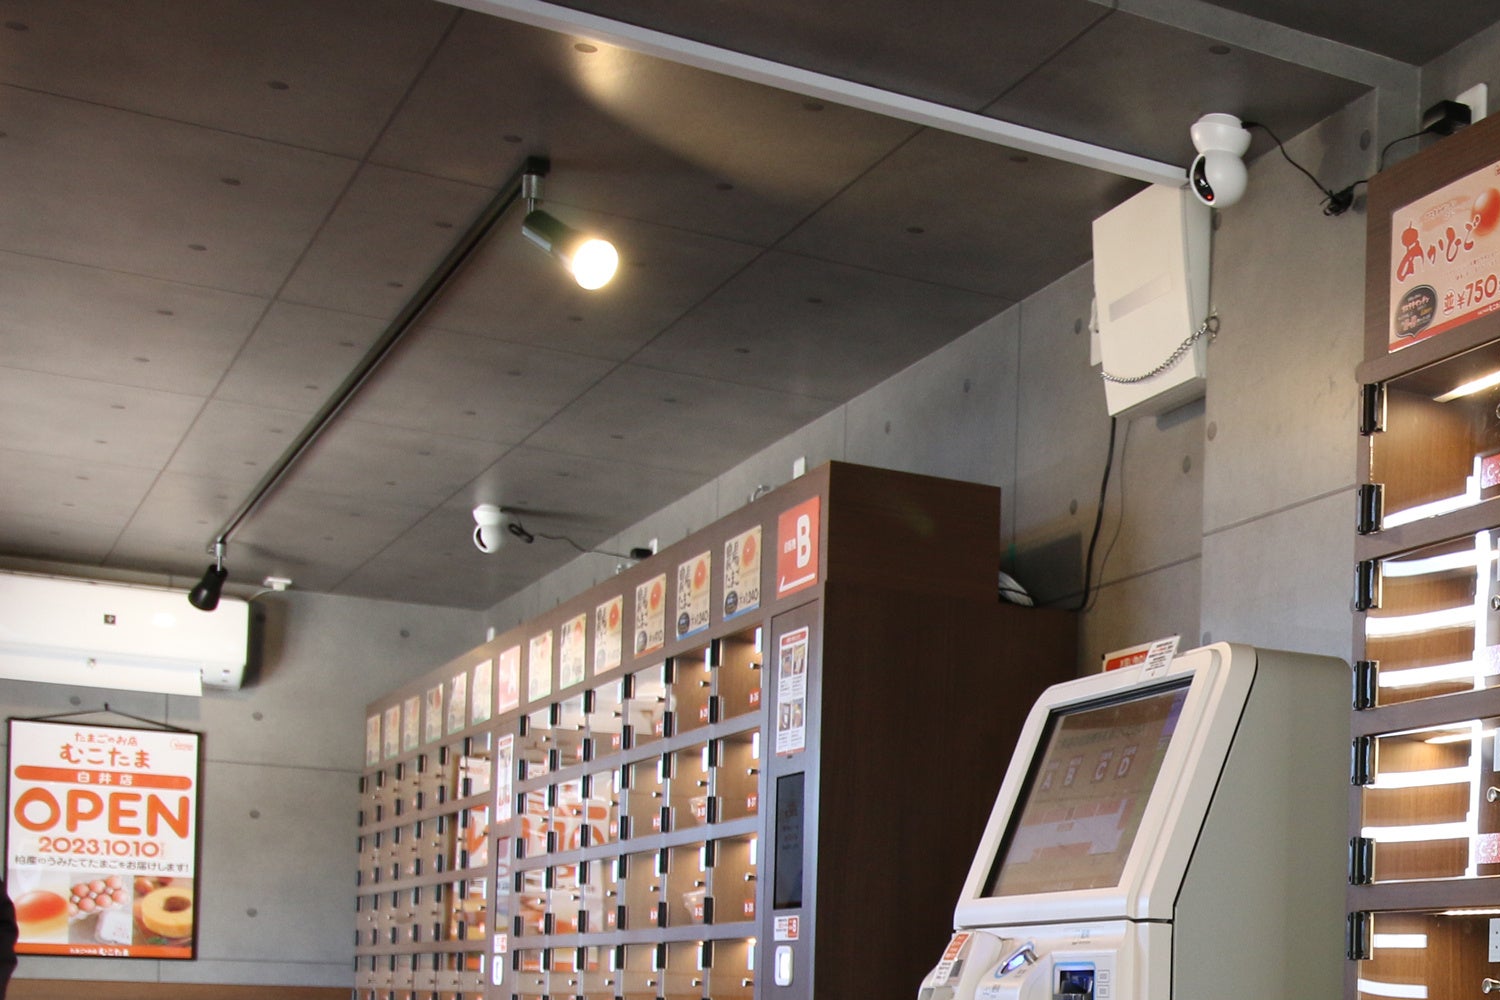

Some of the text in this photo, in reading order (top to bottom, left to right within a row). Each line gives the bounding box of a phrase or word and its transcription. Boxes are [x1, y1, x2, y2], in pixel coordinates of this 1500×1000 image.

[1397, 215, 1480, 282] あかひご
[797, 514, 811, 569] B
[59, 743, 151, 769] むこたま
[76, 773, 133, 786] 白井店
[14, 787, 190, 839] OPEN
[38, 836, 160, 858] 2023.10.10
